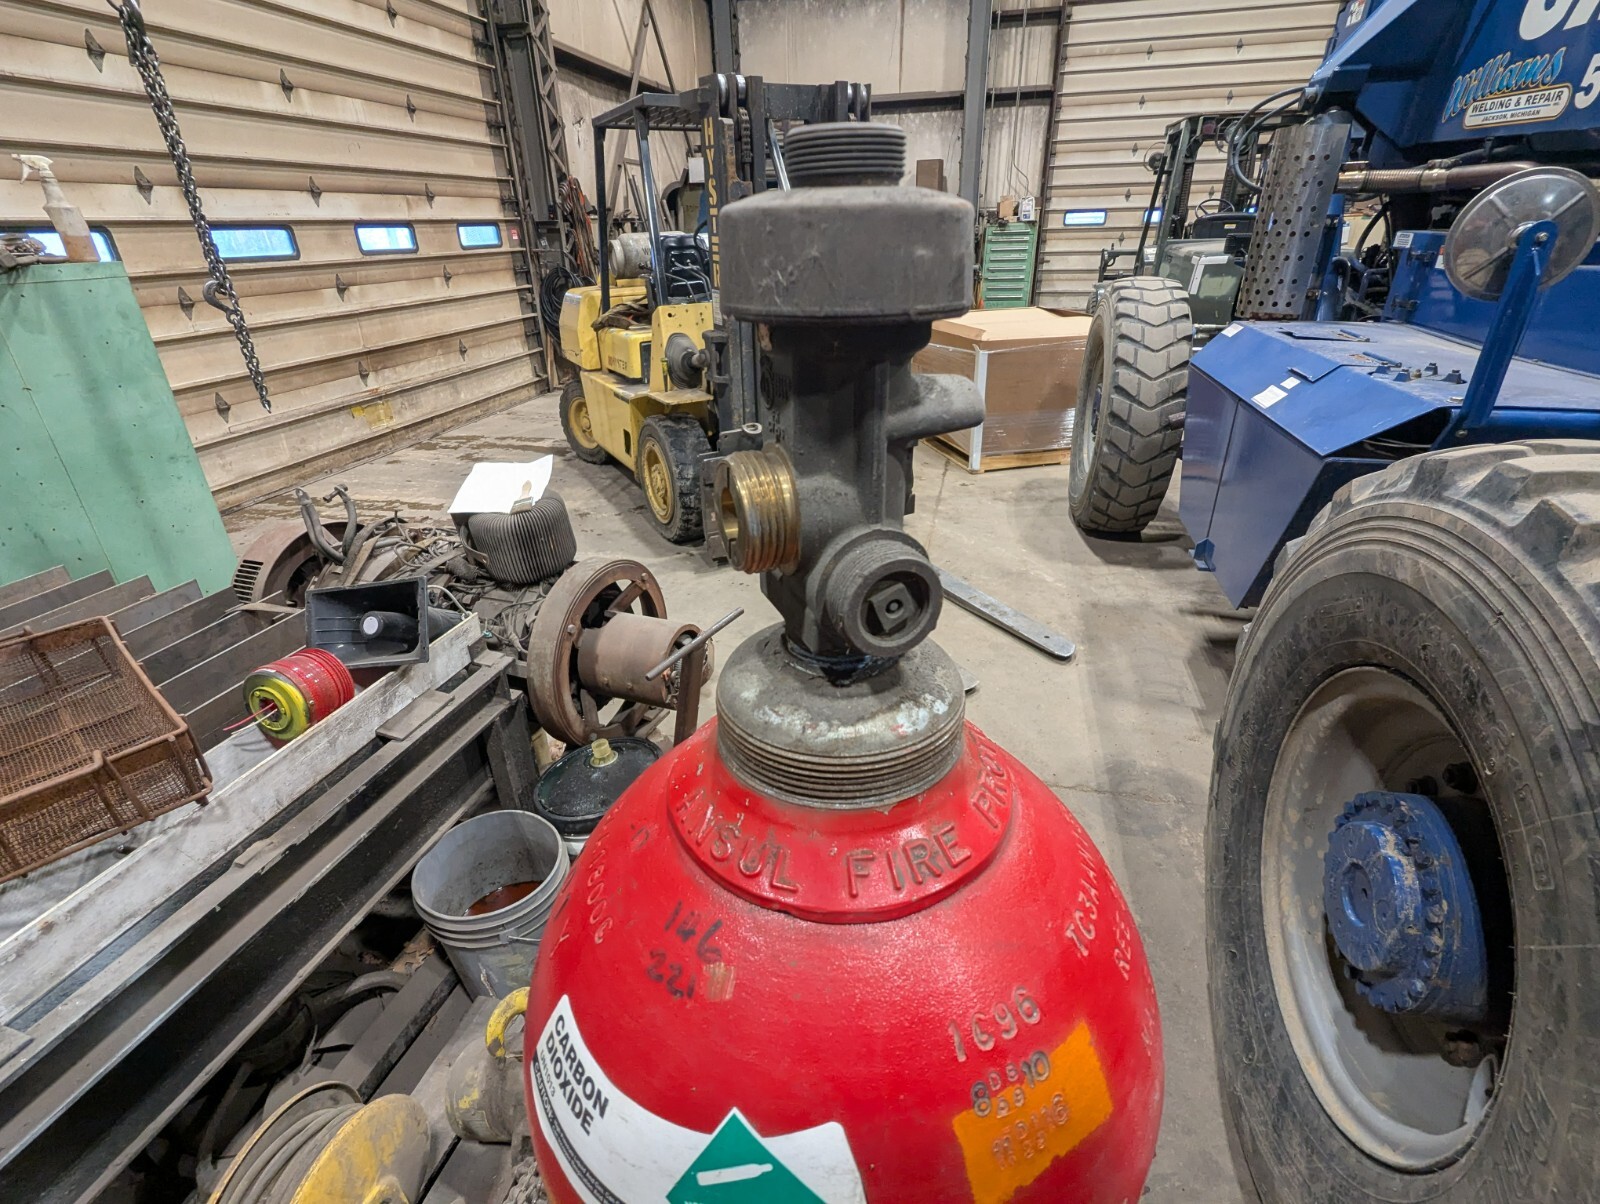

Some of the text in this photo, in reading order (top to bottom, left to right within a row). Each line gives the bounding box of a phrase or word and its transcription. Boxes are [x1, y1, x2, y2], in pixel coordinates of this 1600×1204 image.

[1441, 47, 1567, 123] Williams
[1471, 90, 1564, 114] WELDING & REPAIR
[1481, 109, 1541, 122] JACKSON, MICHIGAN
[675, 788, 800, 893] ANSUL
[846, 824, 972, 899] FIRE
[545, 1031, 595, 1136] DIOXIDE
[554, 1013, 609, 1119] CARBON
